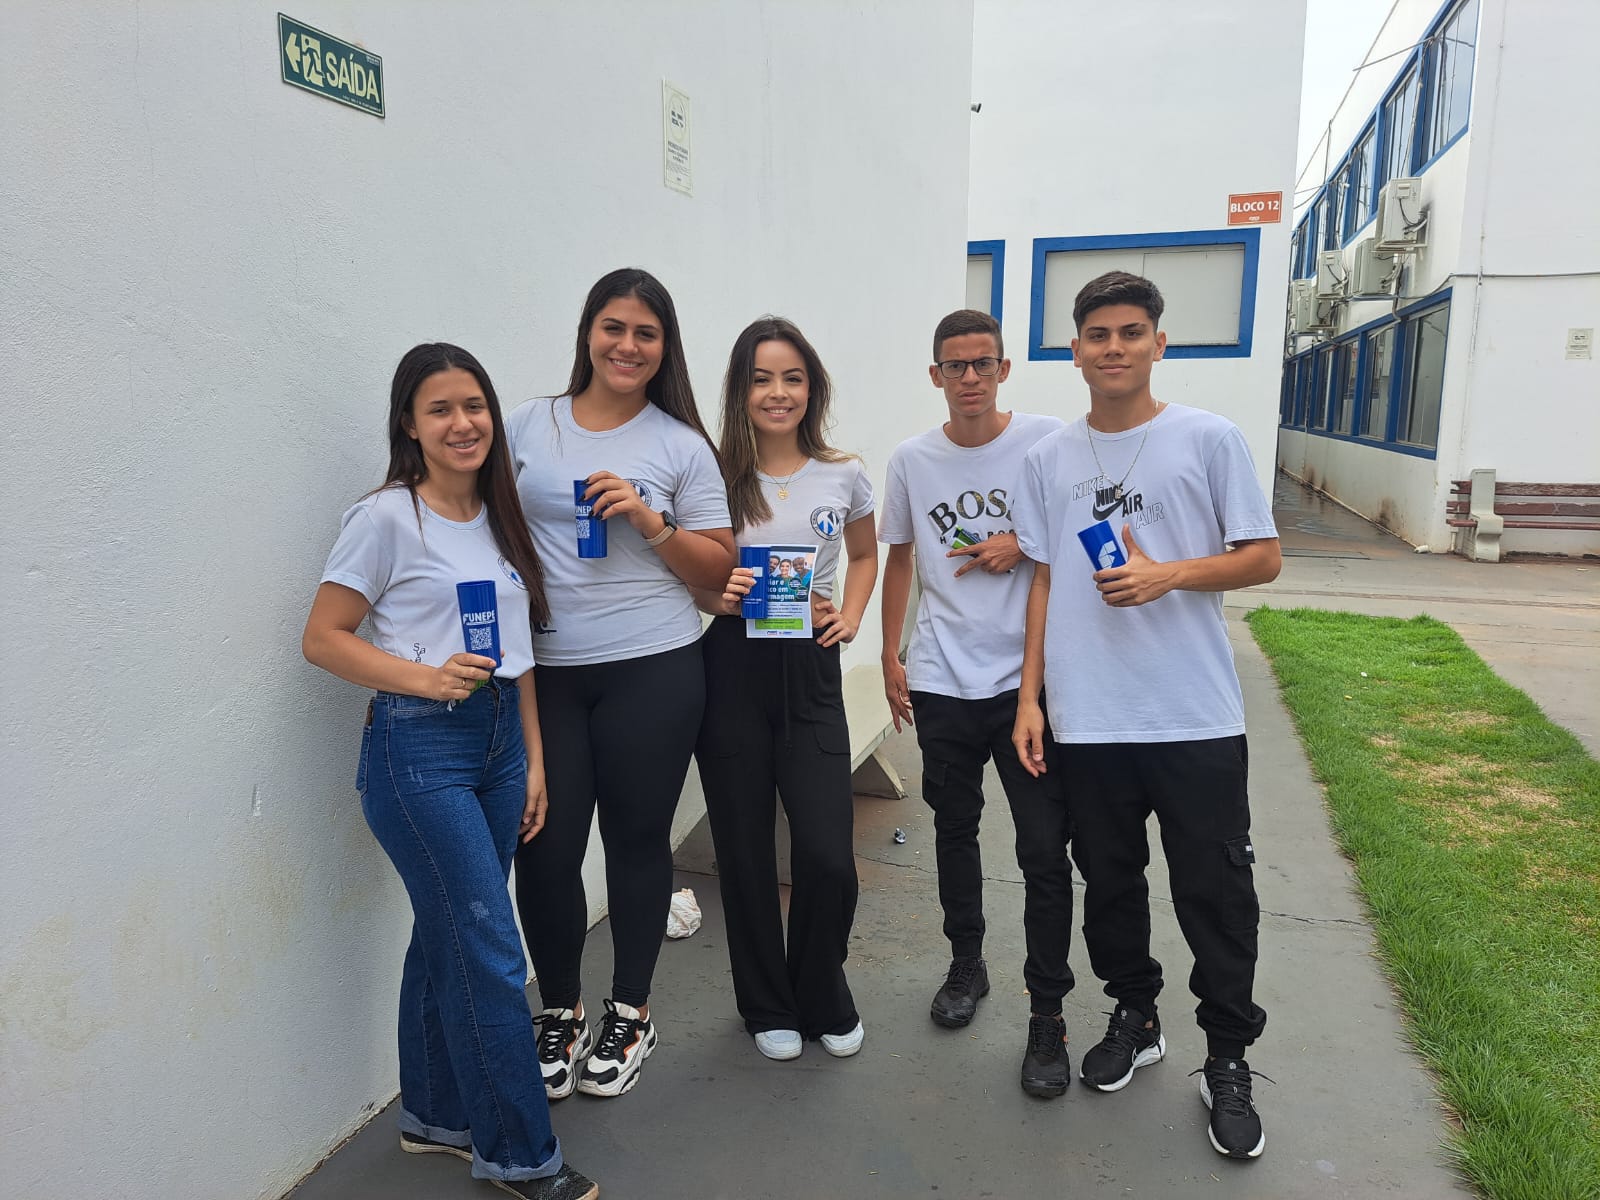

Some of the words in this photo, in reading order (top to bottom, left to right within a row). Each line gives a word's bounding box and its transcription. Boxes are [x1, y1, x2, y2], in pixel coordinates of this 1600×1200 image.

[325, 51, 380, 103] SAÍDA
[1230, 201, 1265, 213] BLOCO
[1267, 200, 1279, 211] 12
[927, 488, 1015, 536] BOS
[1122, 493, 1143, 518] AIR
[1135, 501, 1165, 529] AIR
